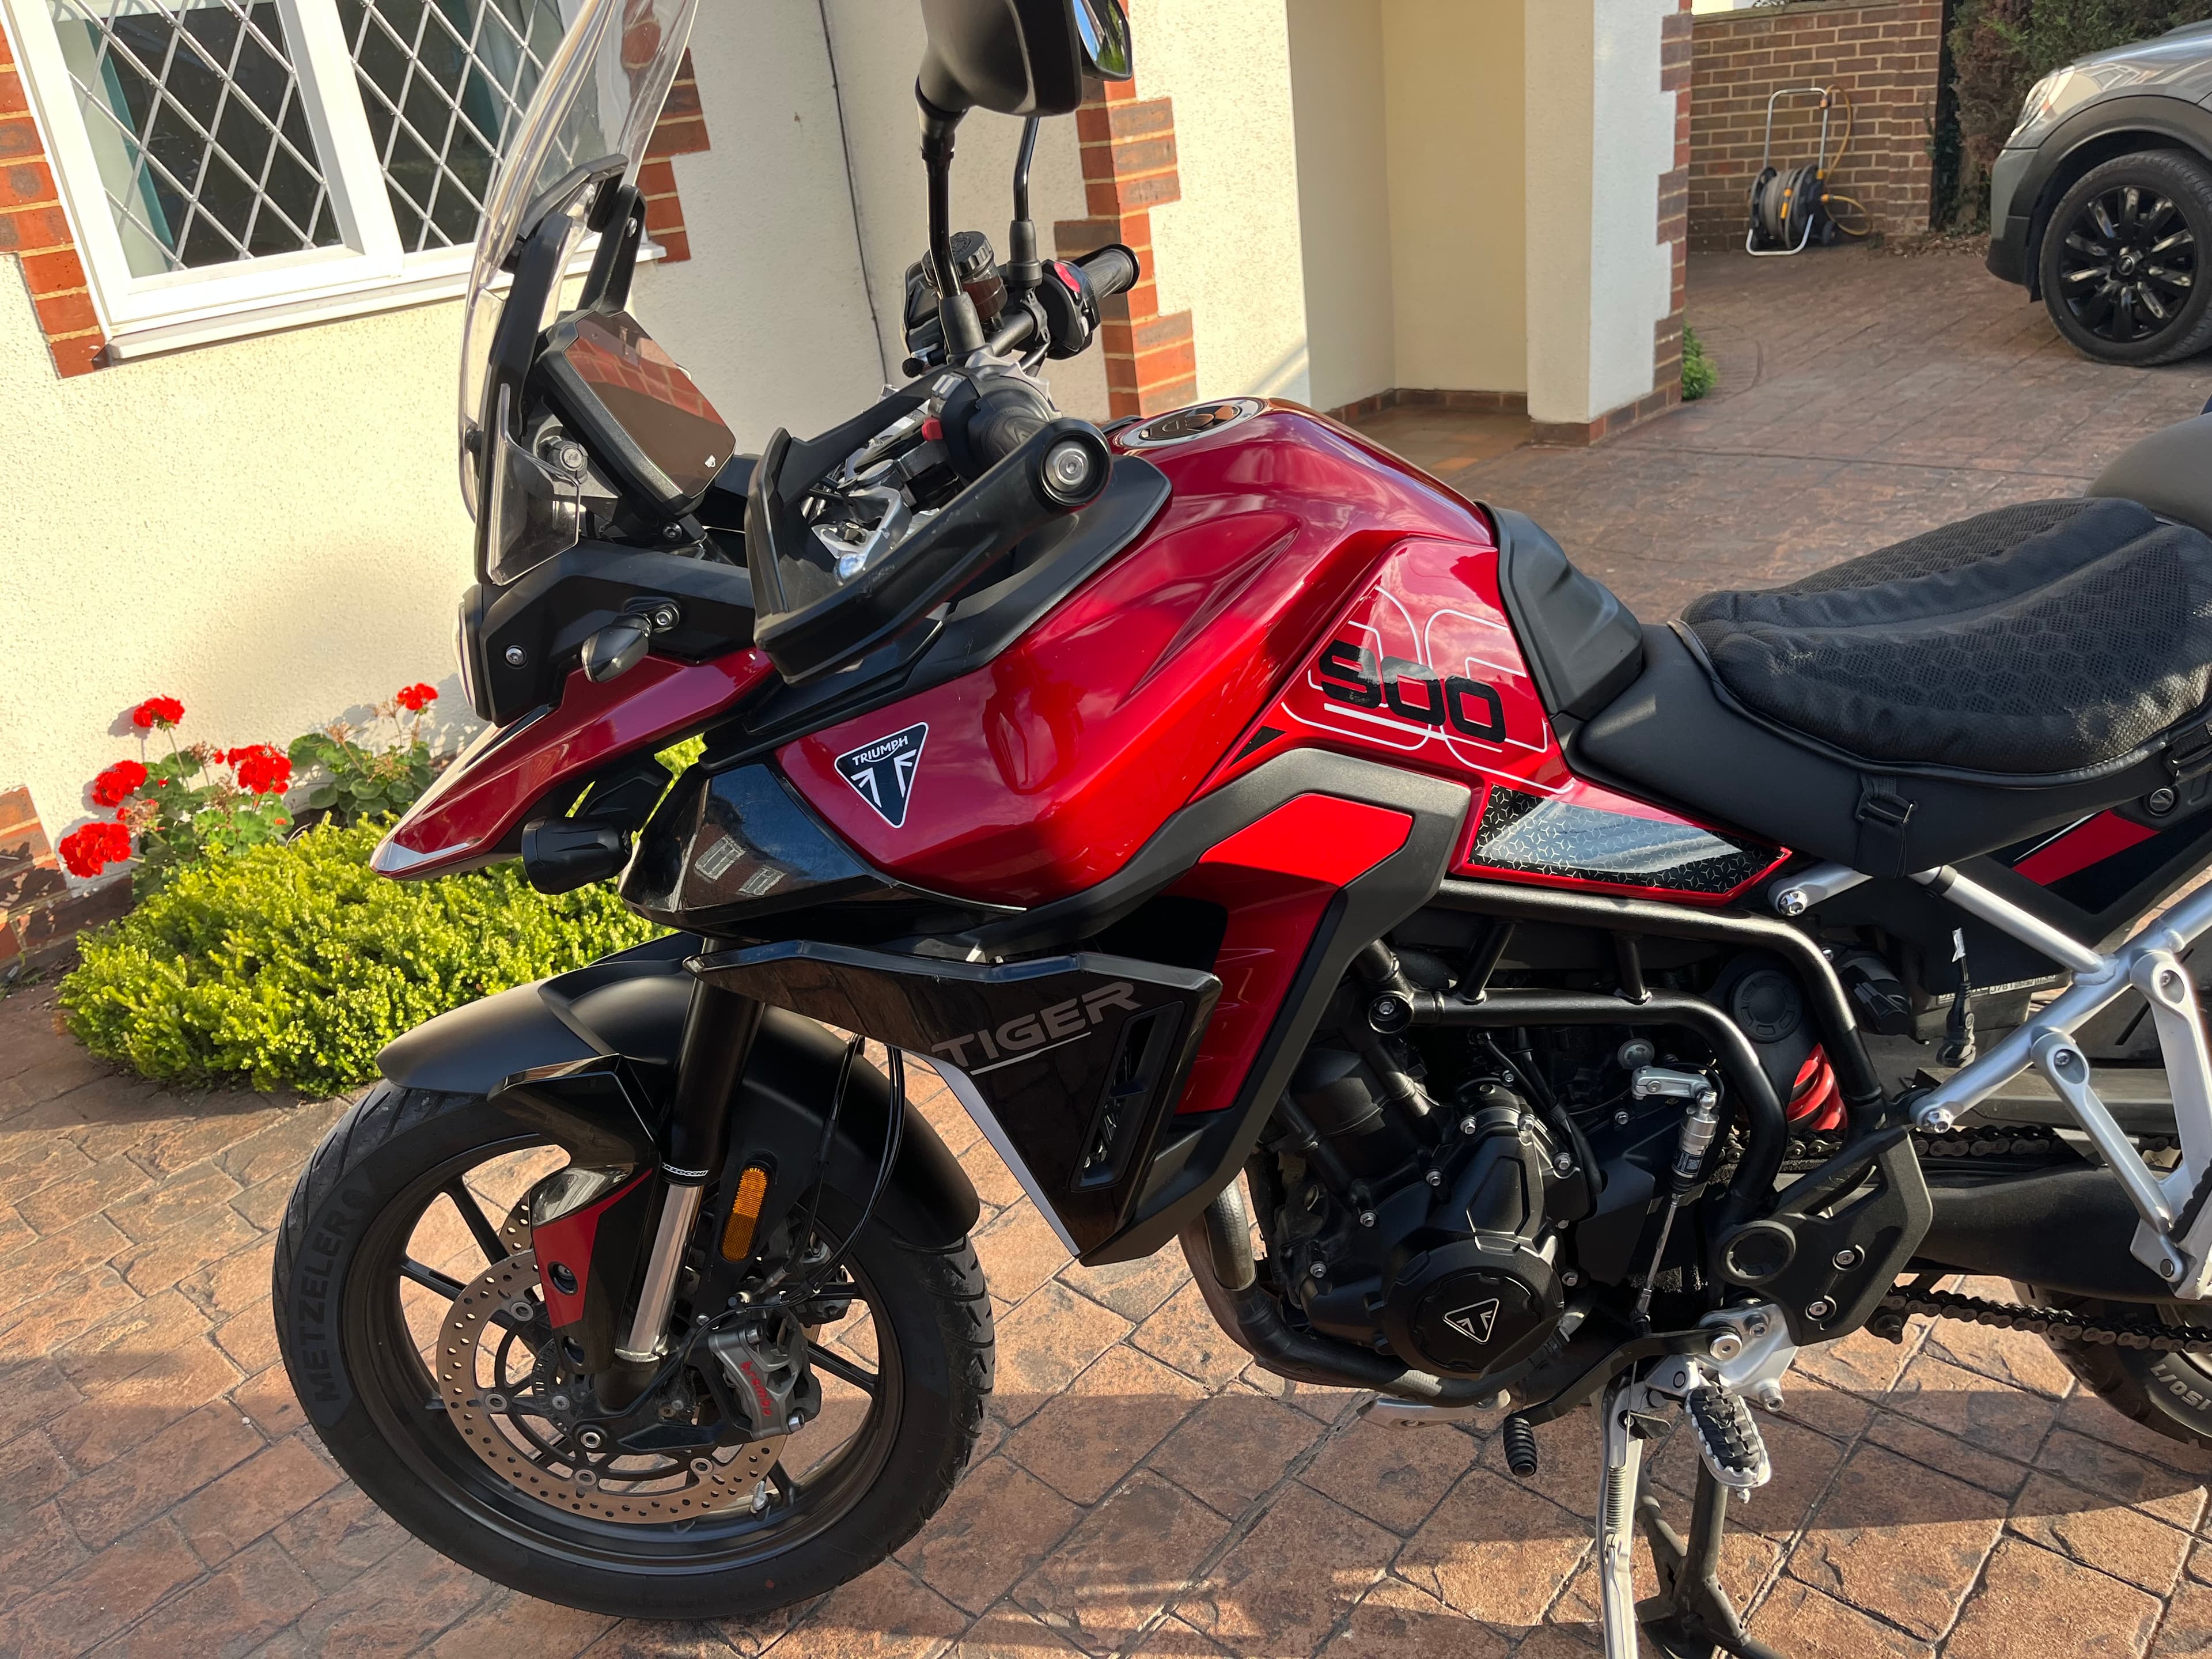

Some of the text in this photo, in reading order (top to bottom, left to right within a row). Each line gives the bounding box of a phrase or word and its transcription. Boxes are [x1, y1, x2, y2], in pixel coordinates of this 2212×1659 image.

[1320, 639, 1506, 743] 900
[852, 735, 908, 766] TRIUMPH
[931, 981, 1142, 1067] TIGER
[661, 1162, 709, 1177] ARZOCCHI
[298, 1209, 356, 1402] METZELER
[740, 1360, 774, 1416] brembo
